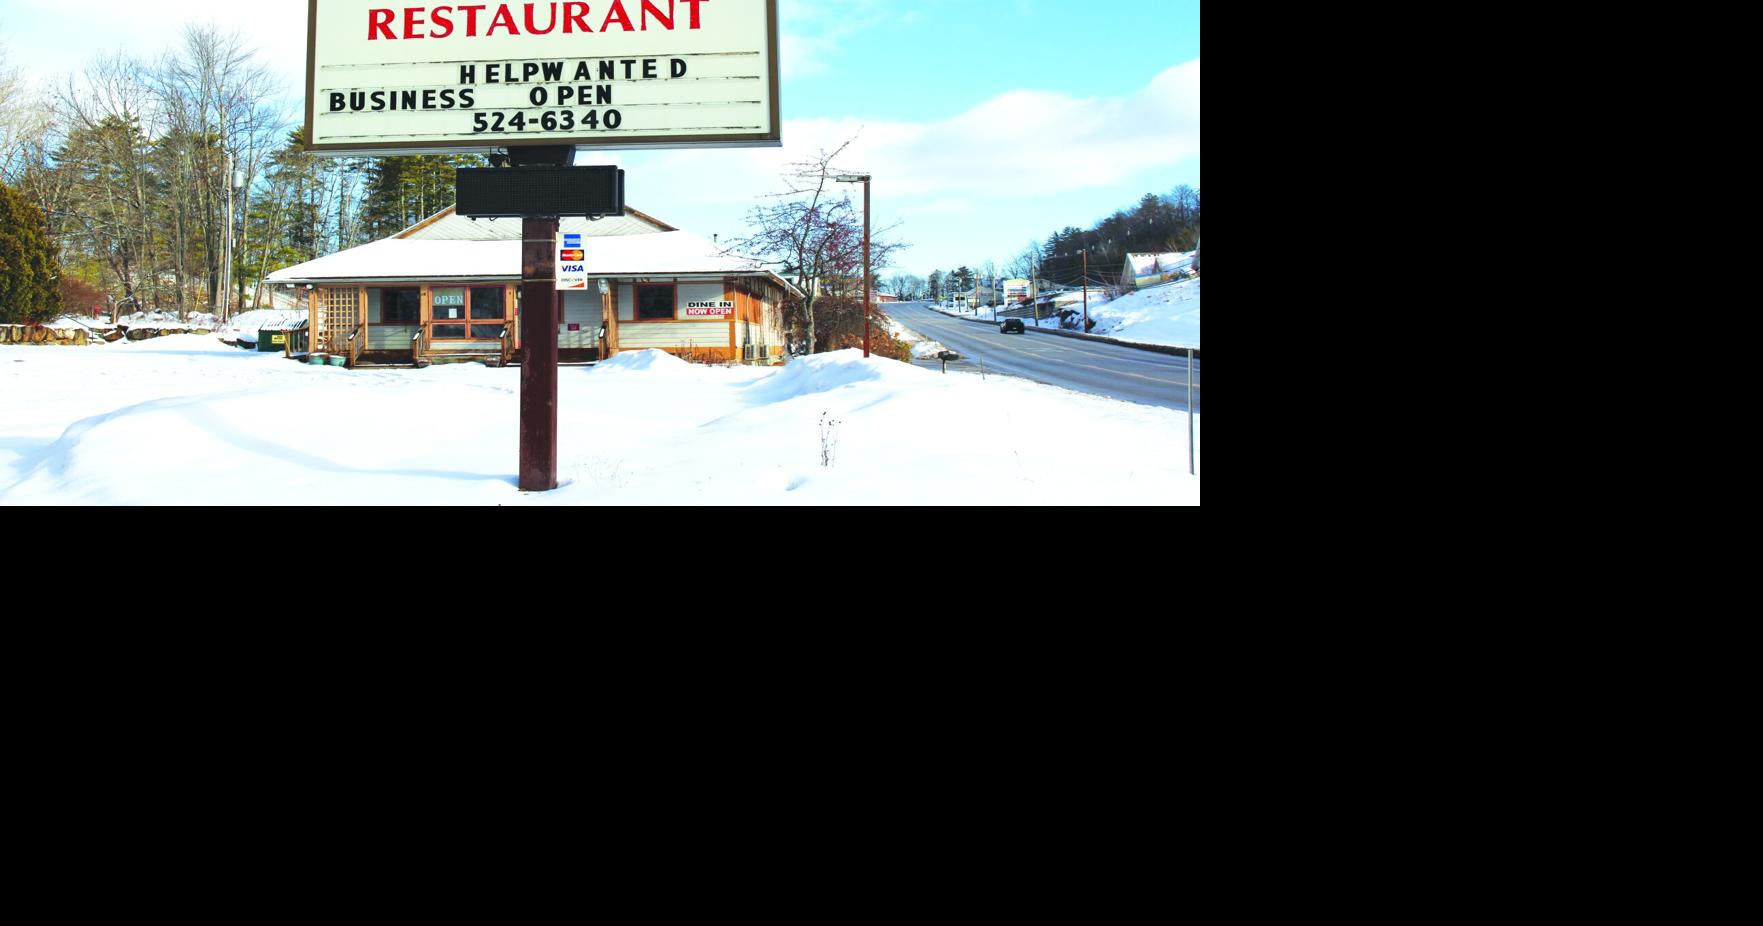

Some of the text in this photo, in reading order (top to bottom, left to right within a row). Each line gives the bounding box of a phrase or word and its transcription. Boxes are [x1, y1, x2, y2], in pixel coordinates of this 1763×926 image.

[368, 0, 709, 40] RESTAURANT
[329, 84, 612, 112] BUSINESS OPEN
[473, 109, 622, 132] 524-6340
[434, 295, 463, 304] OPEN
